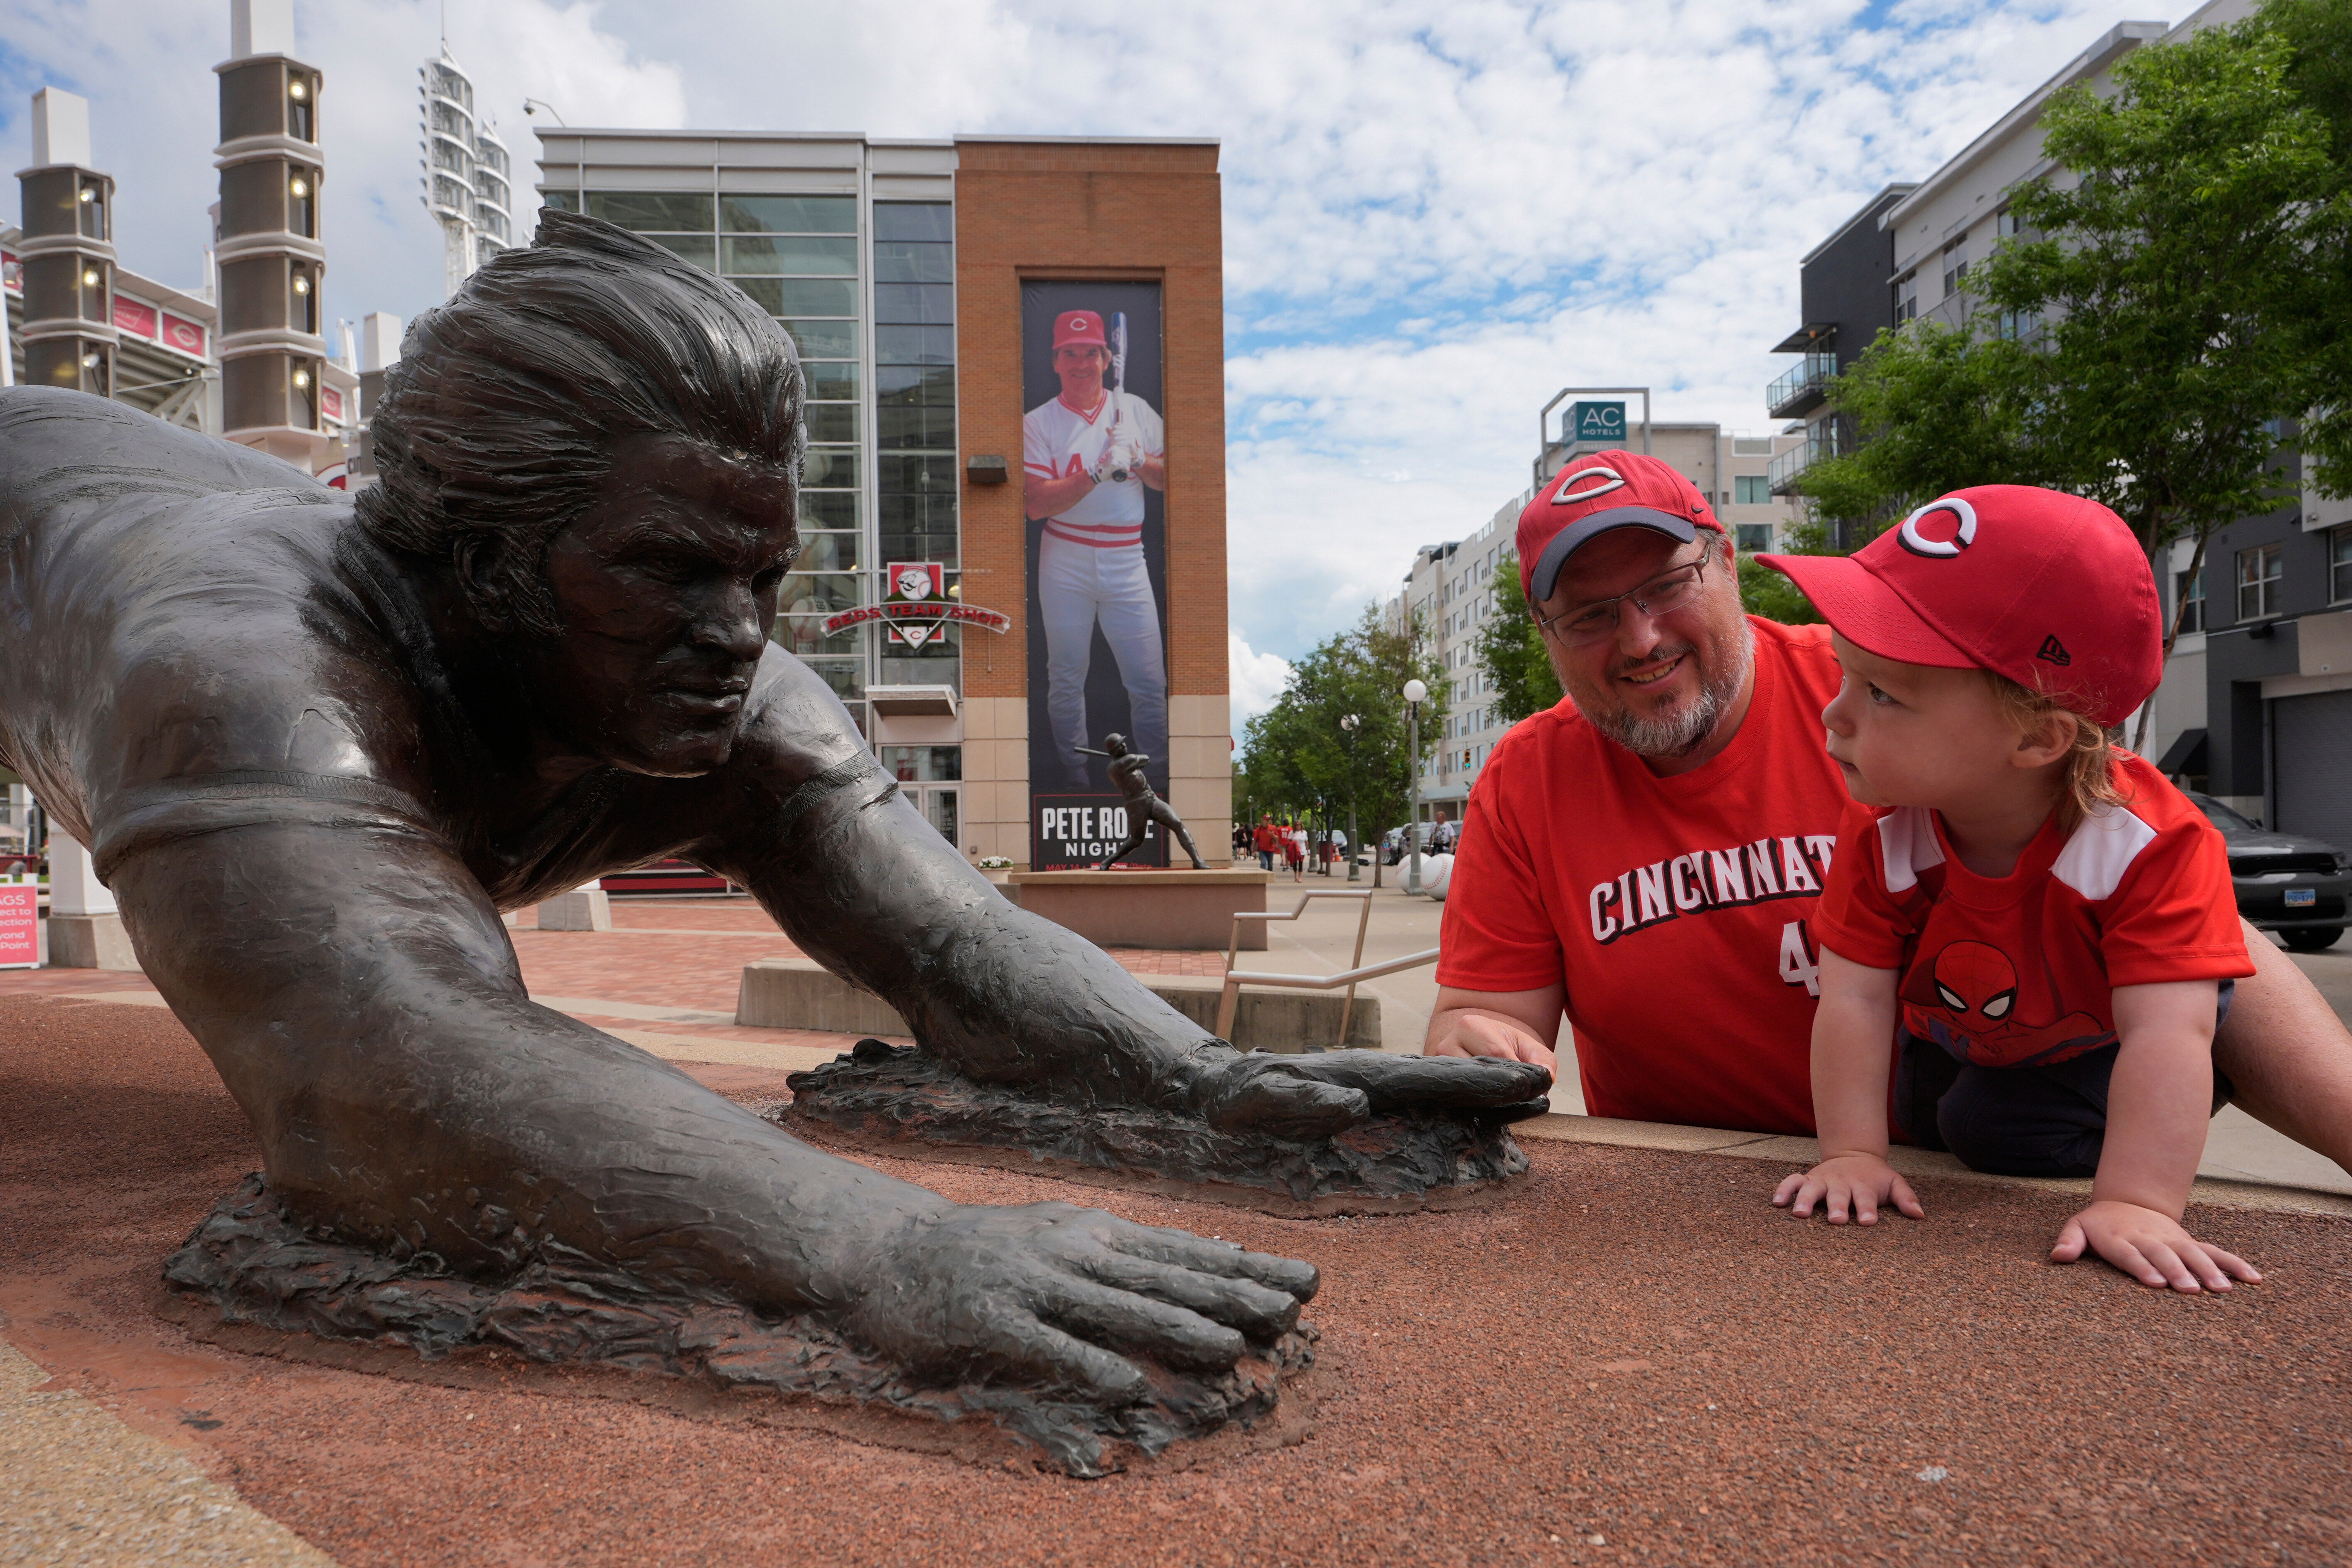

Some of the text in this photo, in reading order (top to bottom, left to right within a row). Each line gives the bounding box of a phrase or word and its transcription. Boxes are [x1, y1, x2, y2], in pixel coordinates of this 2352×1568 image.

[1583, 408, 1620, 427] AC
[1897, 498, 1977, 558] C
[827, 605, 1003, 630] REDS TEAM SHOP
[1042, 807, 1093, 840] PETE
[1066, 842, 1123, 856] NIGH
[0, 941, 30, 950] Point
